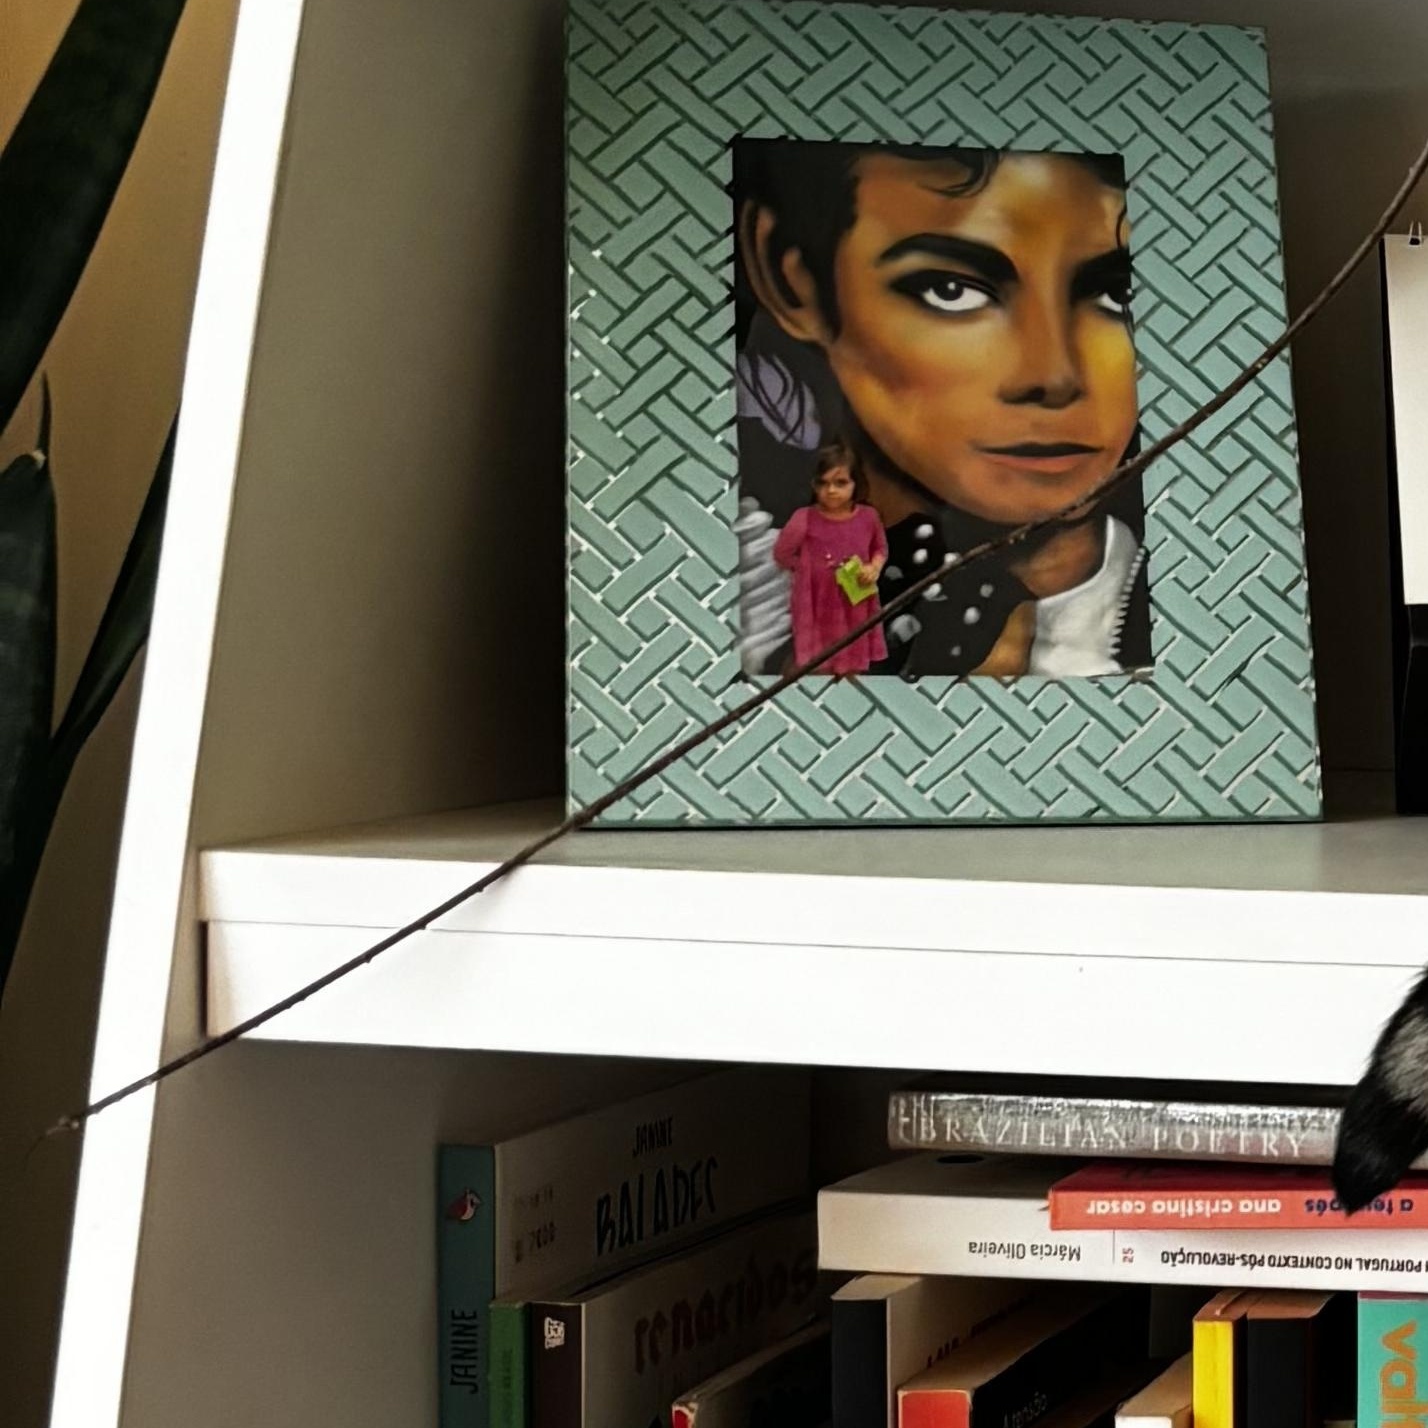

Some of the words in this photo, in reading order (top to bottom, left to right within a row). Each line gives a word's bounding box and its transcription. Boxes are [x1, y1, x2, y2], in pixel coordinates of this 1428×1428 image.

[1154, 1130, 1313, 1158] POETRY
[1087, 1201, 1146, 1215] cesar
[1148, 1201, 1231, 1220] cristina
[1234, 1201, 1281, 1214] ana
[968, 1242, 1025, 1259] Oliveira
[1029, 1244, 1082, 1263] Márcia
[1160, 1249, 1265, 1272] PÓS-REVOLUÇÃO
[1267, 1256, 1332, 1272] CONTEXTO
[1356, 1257, 1421, 1274] PORTUGAL
[450, 1309, 480, 1395] JANINE
